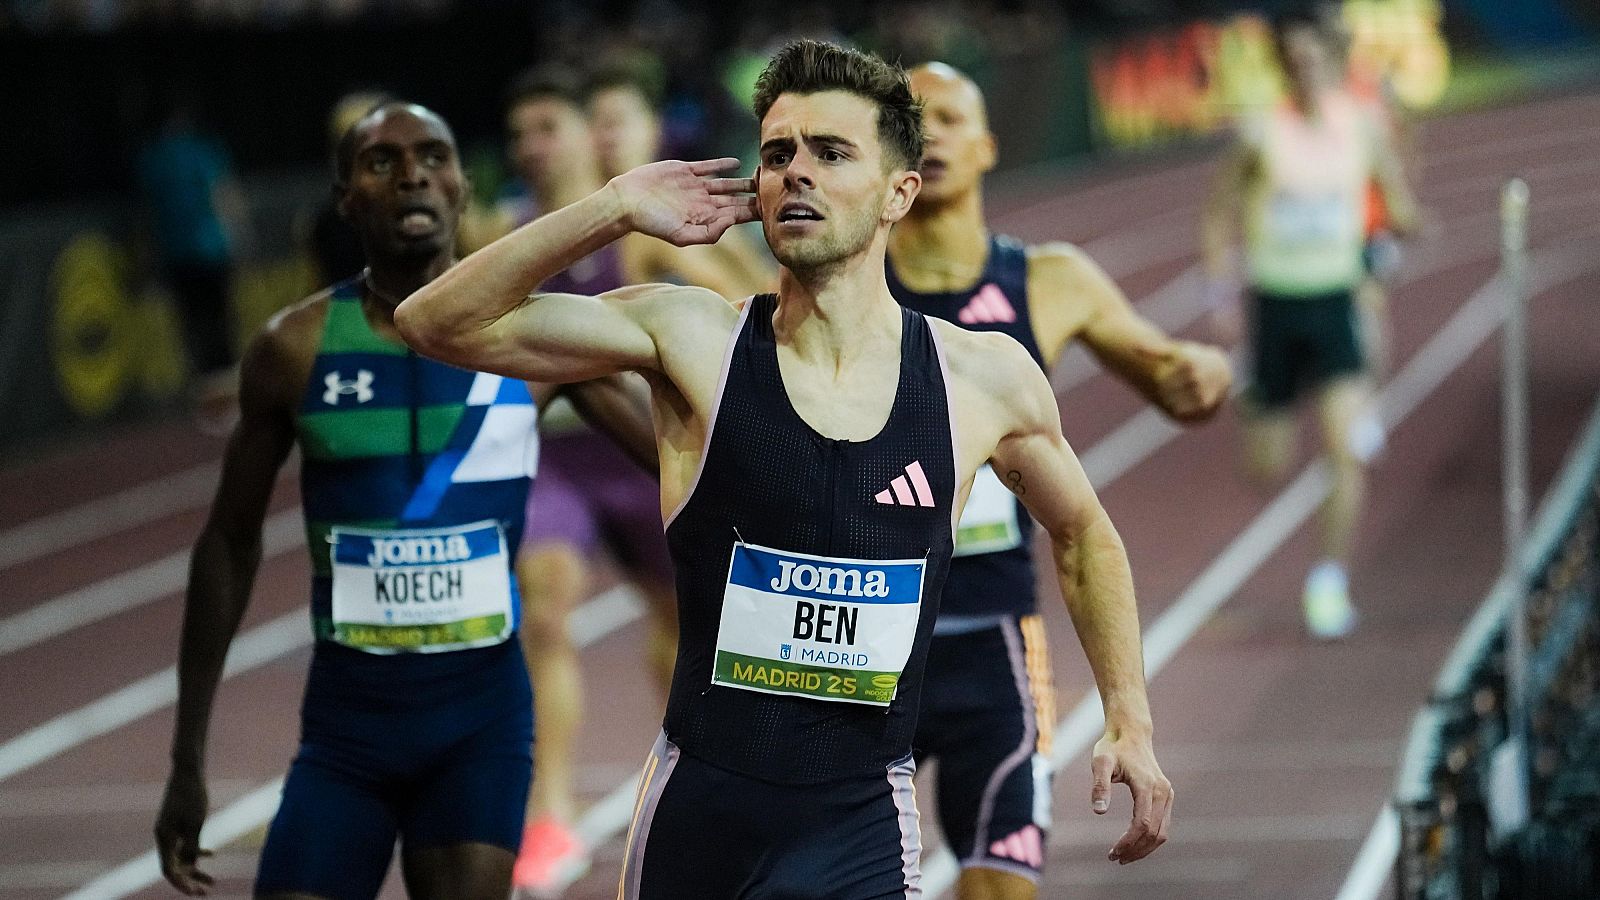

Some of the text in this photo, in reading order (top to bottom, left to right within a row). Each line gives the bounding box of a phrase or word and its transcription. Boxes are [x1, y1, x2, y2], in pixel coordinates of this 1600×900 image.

[374, 569, 463, 603] KOECH
[770, 560, 889, 598] Joma
[792, 600, 859, 646] BEN
[801, 648, 868, 667] MADRID
[732, 661, 857, 695] MADRID 25
